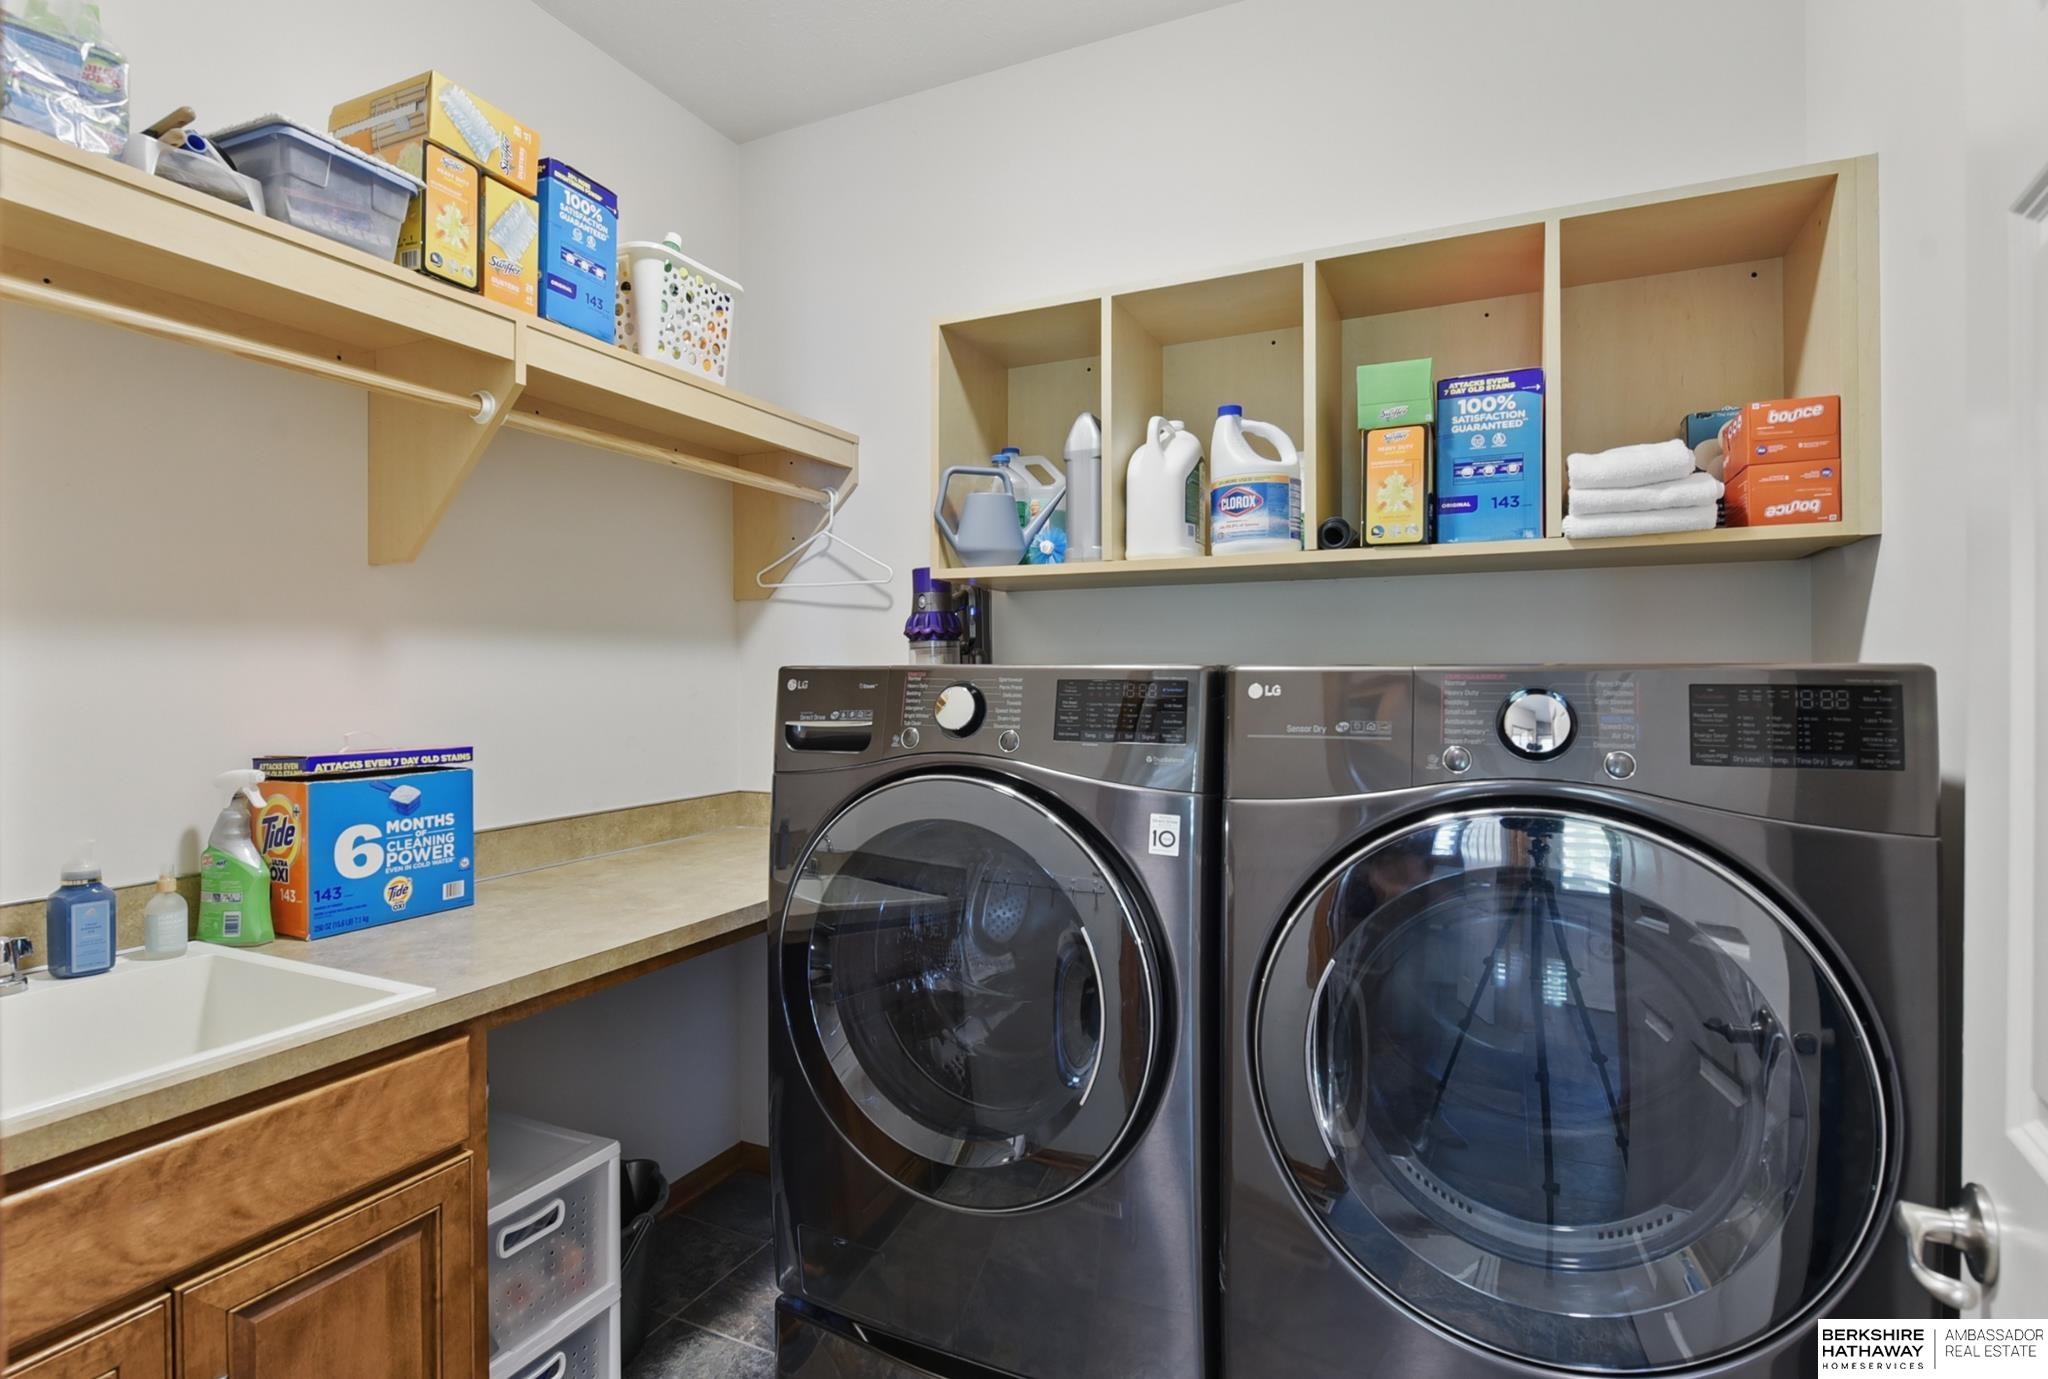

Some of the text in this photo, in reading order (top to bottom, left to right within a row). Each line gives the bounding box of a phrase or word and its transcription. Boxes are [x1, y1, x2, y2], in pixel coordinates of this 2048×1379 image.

[564, 189, 603, 223] 100%
[560, 202, 608, 234] SATISFACTION
[488, 254, 523, 275] Swiffer
[585, 292, 604, 310] 143
[1448, 376, 1510, 390] ATTACKS EVEN
[1450, 387, 1467, 395] DAY
[1467, 385, 1485, 393] OLD
[1485, 381, 1516, 392] STAINS
[1457, 394, 1516, 415] 100%
[1451, 409, 1526, 425] SATISFACTION
[1767, 404, 1824, 424] bounce
[1221, 495, 1257, 511] CLOROX
[1490, 495, 1520, 509] 143
[1765, 499, 1821, 518] bounce
[1286, 724, 1328, 735] Sensor Dry
[315, 752, 472, 774] ATTACKS EVEN 7 DAY OLD STAINS
[386, 812, 455, 834] MONTHS
[262, 815, 295, 855] Tide
[415, 829, 427, 837] OF
[1153, 830, 1176, 848] 10
[334, 823, 385, 880] 6
[386, 832, 455, 853] CLEANING
[386, 843, 455, 868] POWER
[270, 866, 289, 883] OXI
[385, 866, 404, 874] EVEN
[412, 862, 431, 870] COLD
[279, 888, 296, 903] 143
[313, 886, 342, 903] 143
[388, 883, 409, 901] Tide
[393, 903, 406, 911] OXI
